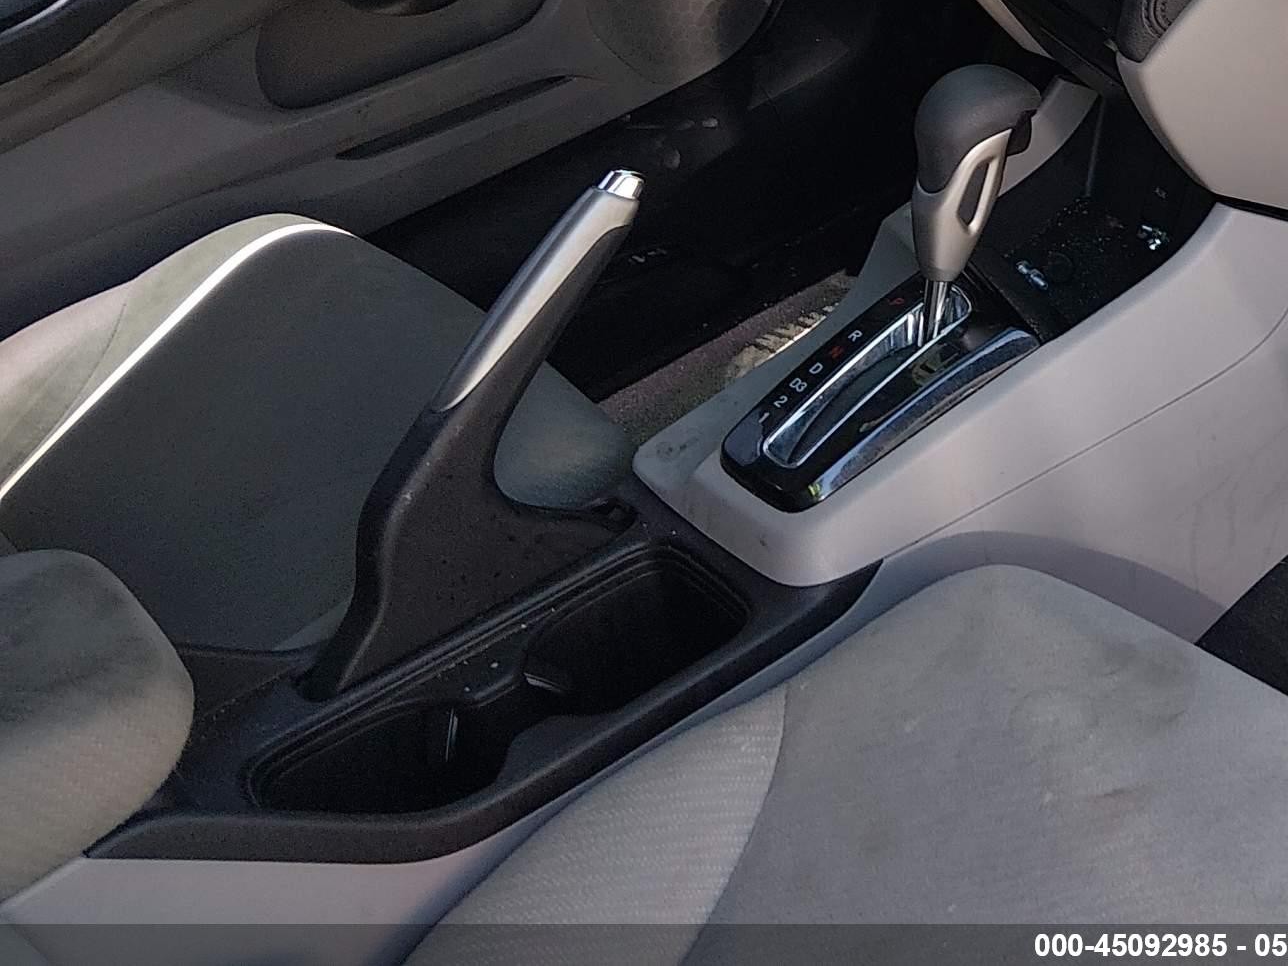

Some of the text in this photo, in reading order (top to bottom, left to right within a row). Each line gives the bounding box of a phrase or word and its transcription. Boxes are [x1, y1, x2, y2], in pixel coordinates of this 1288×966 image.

[847, 329, 863, 343] R
[809, 362, 823, 375] D
[774, 395, 788, 408] 2
[758, 411, 770, 424] 1
